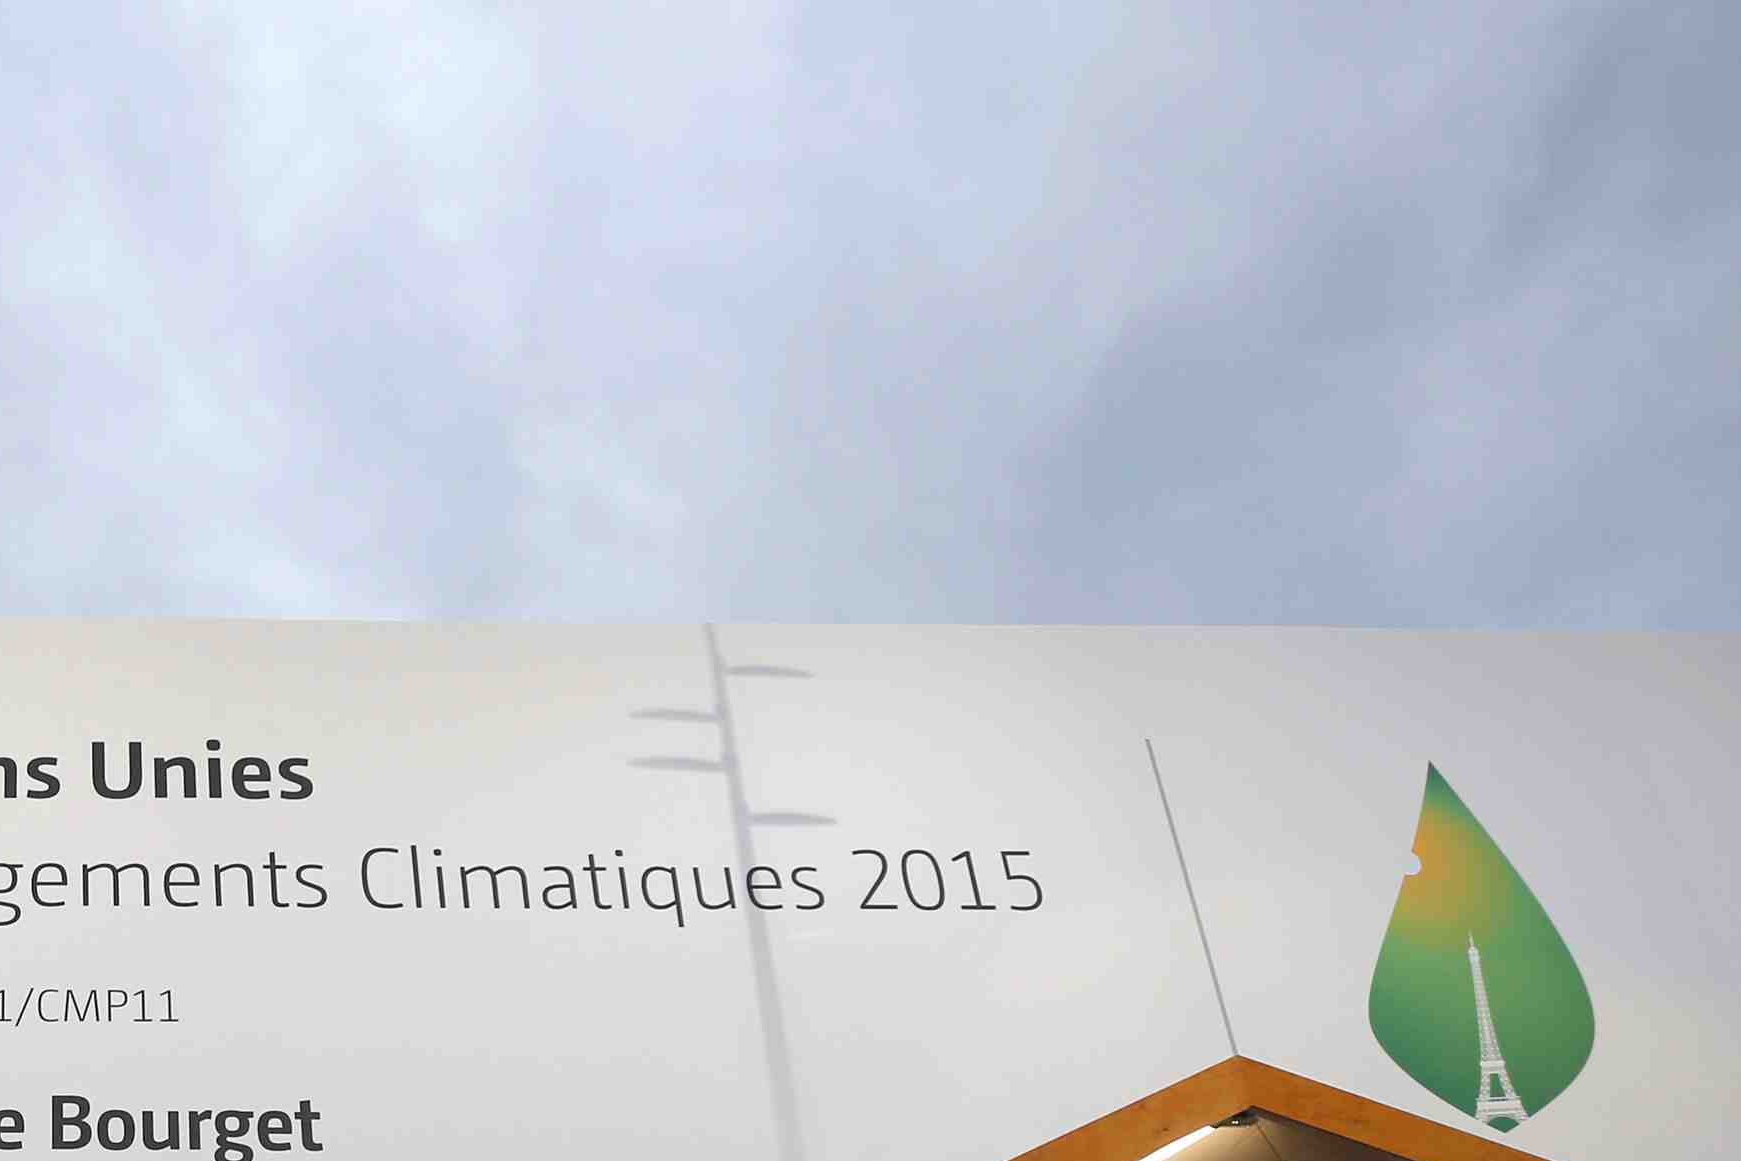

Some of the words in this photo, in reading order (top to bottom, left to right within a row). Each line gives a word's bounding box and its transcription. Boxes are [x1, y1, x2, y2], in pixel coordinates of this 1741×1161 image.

[91, 739, 314, 800] Unies
[360, 844, 826, 928] Climatiques
[851, 848, 1044, 911] 2015
